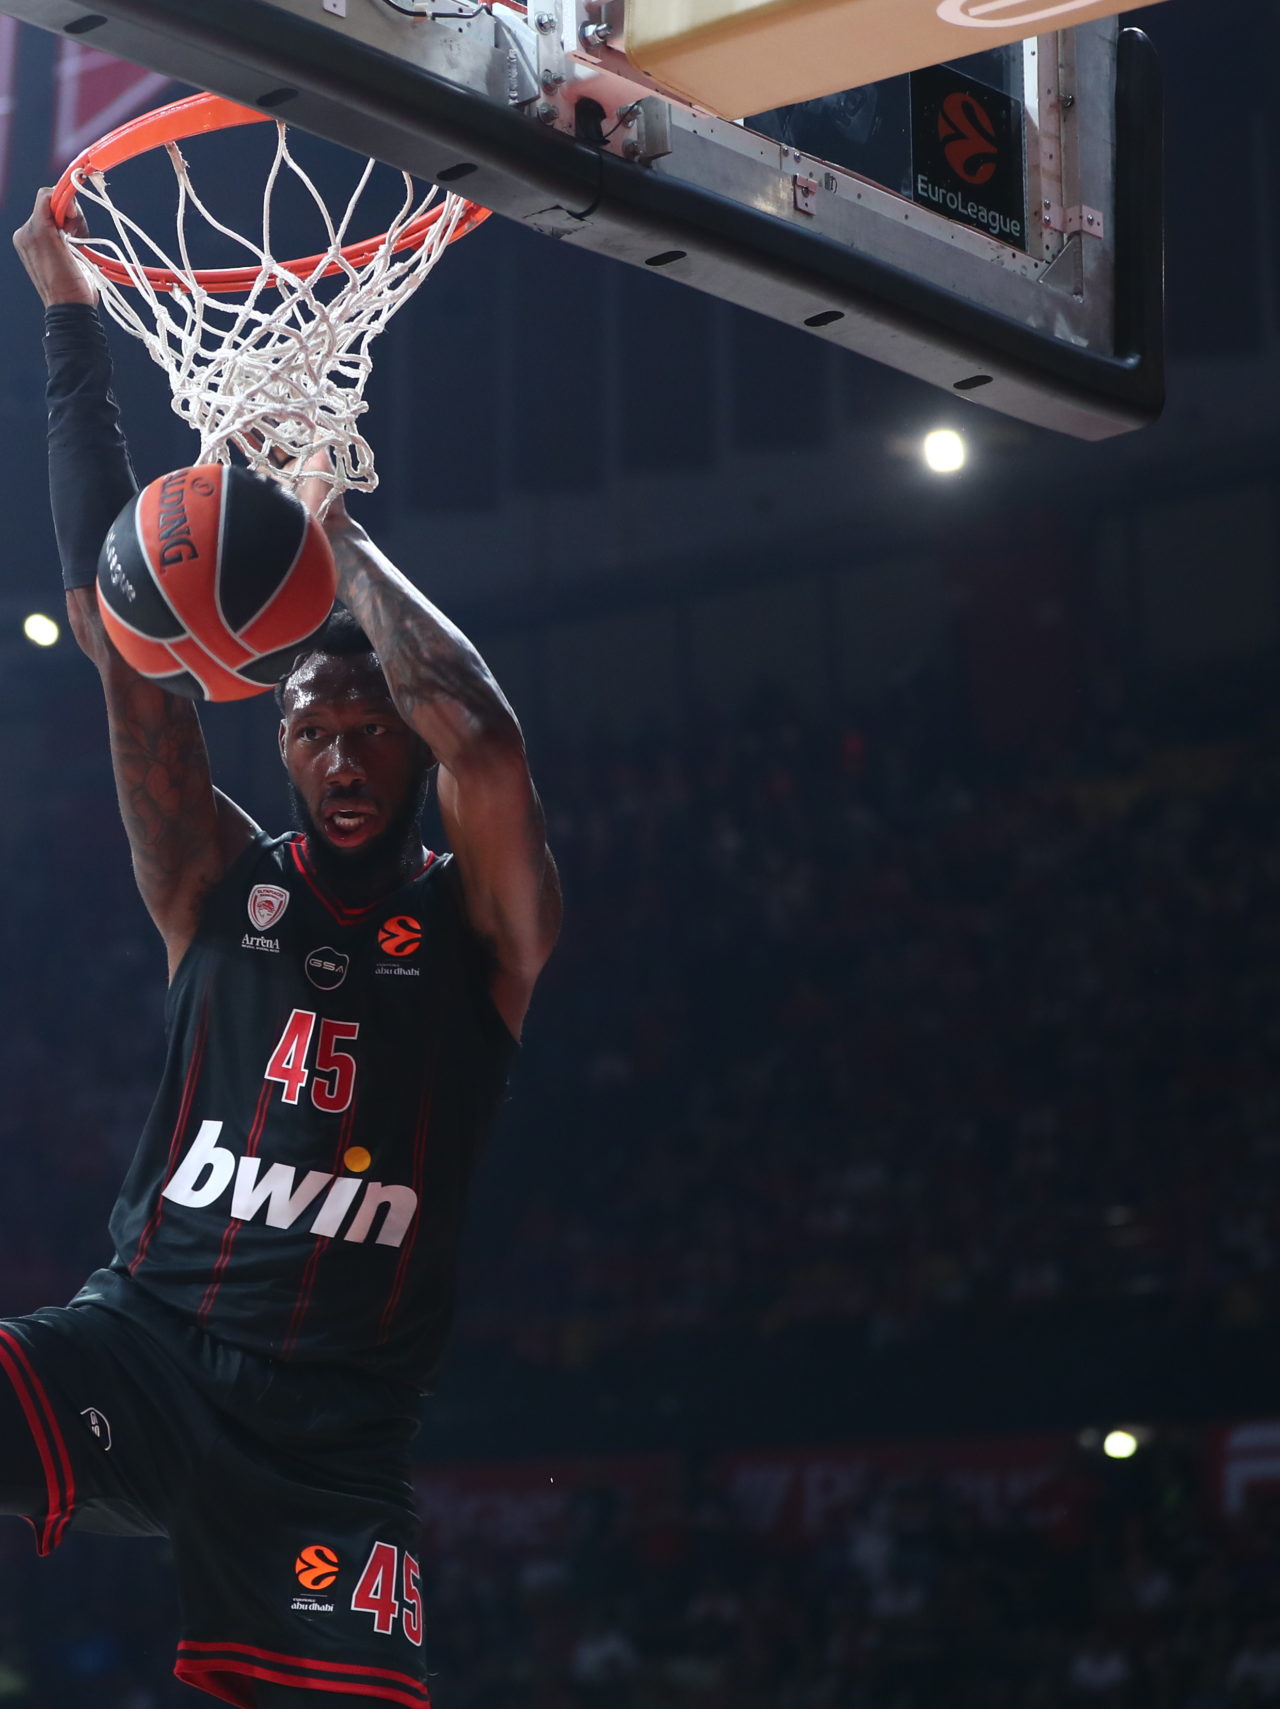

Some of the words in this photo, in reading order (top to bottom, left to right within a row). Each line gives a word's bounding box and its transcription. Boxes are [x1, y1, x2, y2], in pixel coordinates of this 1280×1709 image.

[916, 174, 1021, 237] EuroLeague
[309, 958, 345, 974] GSA
[264, 1008, 360, 1113] 45
[161, 1120, 418, 1248] bwin
[90, 1411, 101, 1438] GS
[351, 1540, 423, 1647] 45
